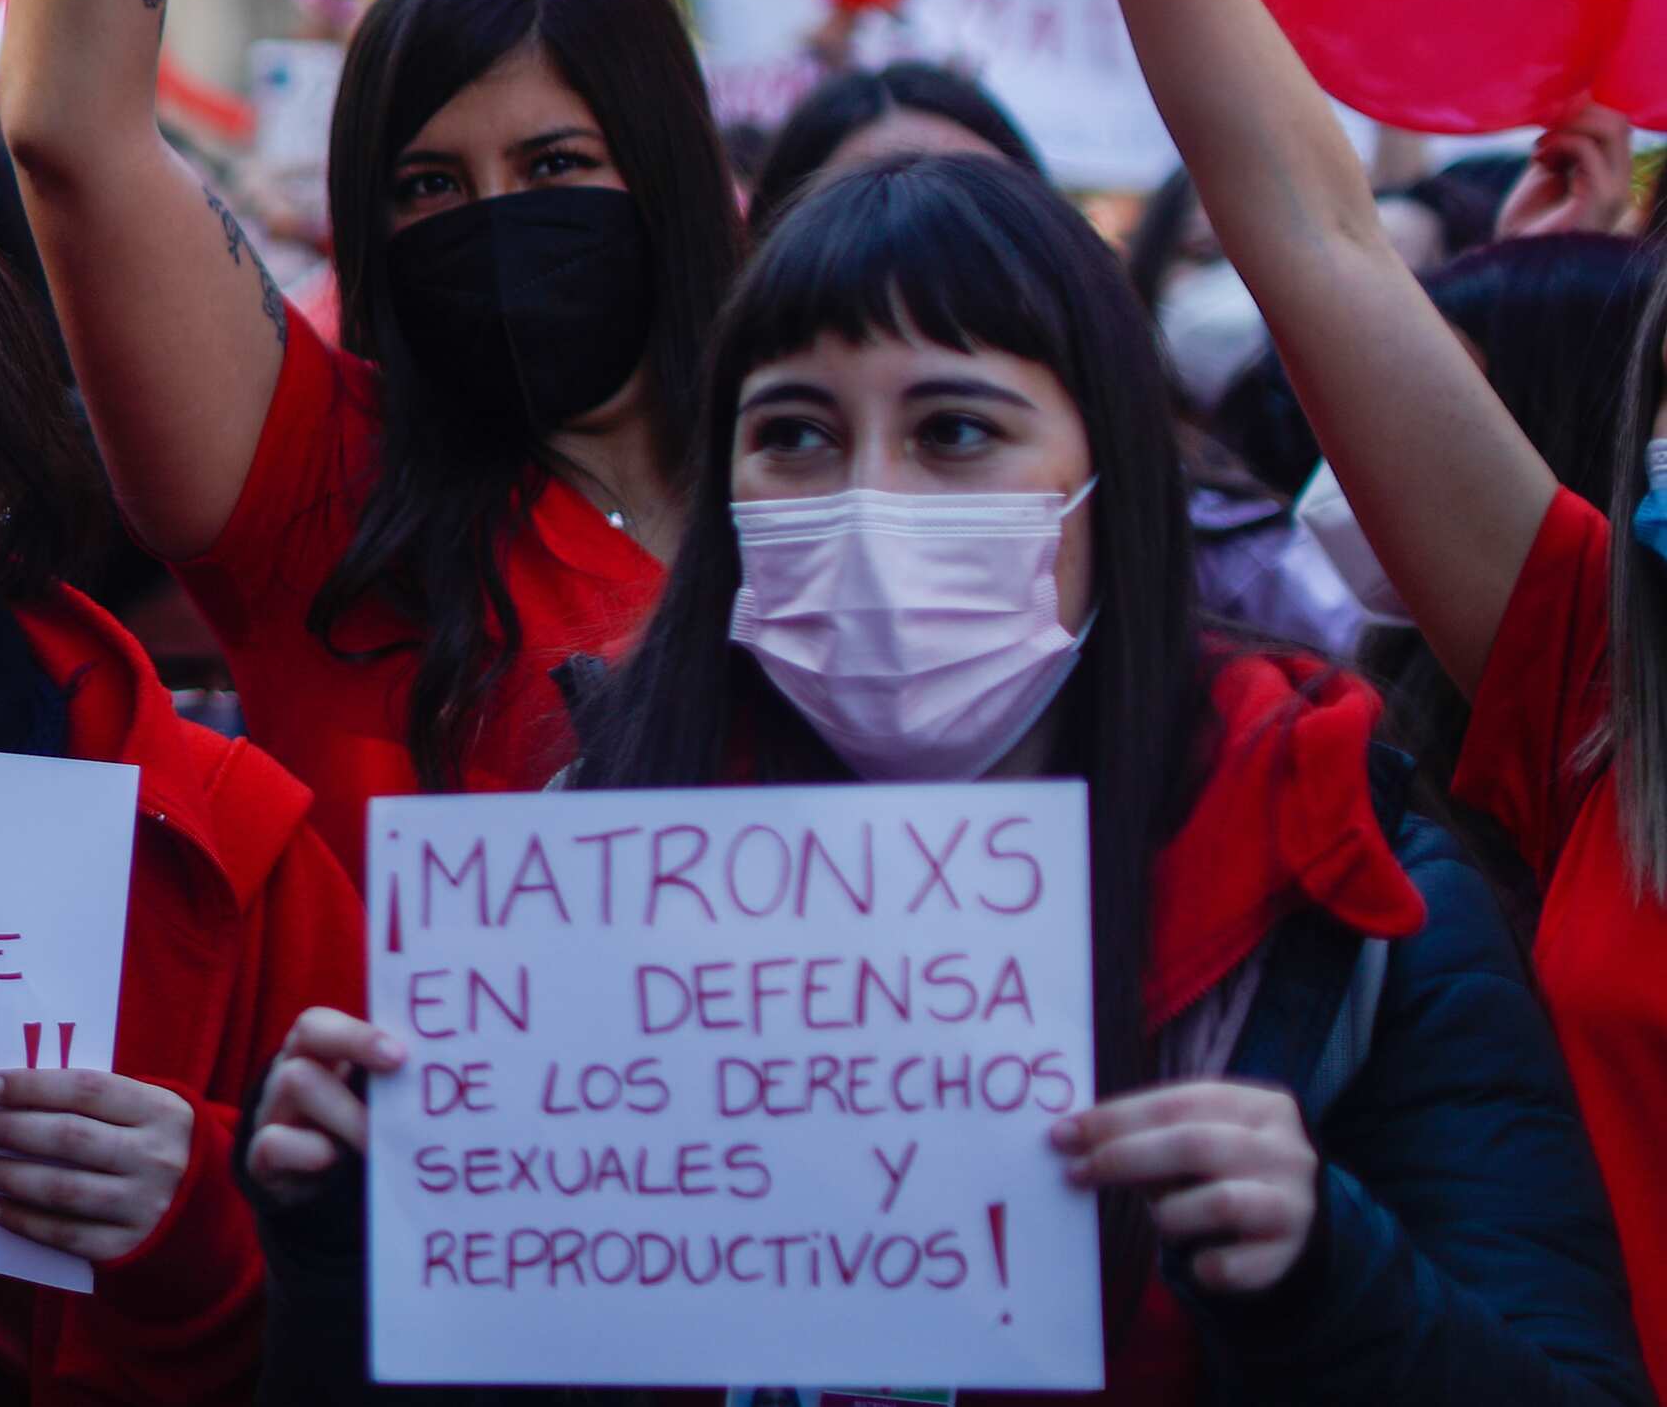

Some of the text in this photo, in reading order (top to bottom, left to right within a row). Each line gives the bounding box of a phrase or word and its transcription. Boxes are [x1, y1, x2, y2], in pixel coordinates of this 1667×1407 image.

[409, 953, 1034, 1039] EN DEFENSA
[420, 1050, 1076, 1117] DE LOS DERECHOS
[413, 1142, 919, 1213] SEXUALES Y
